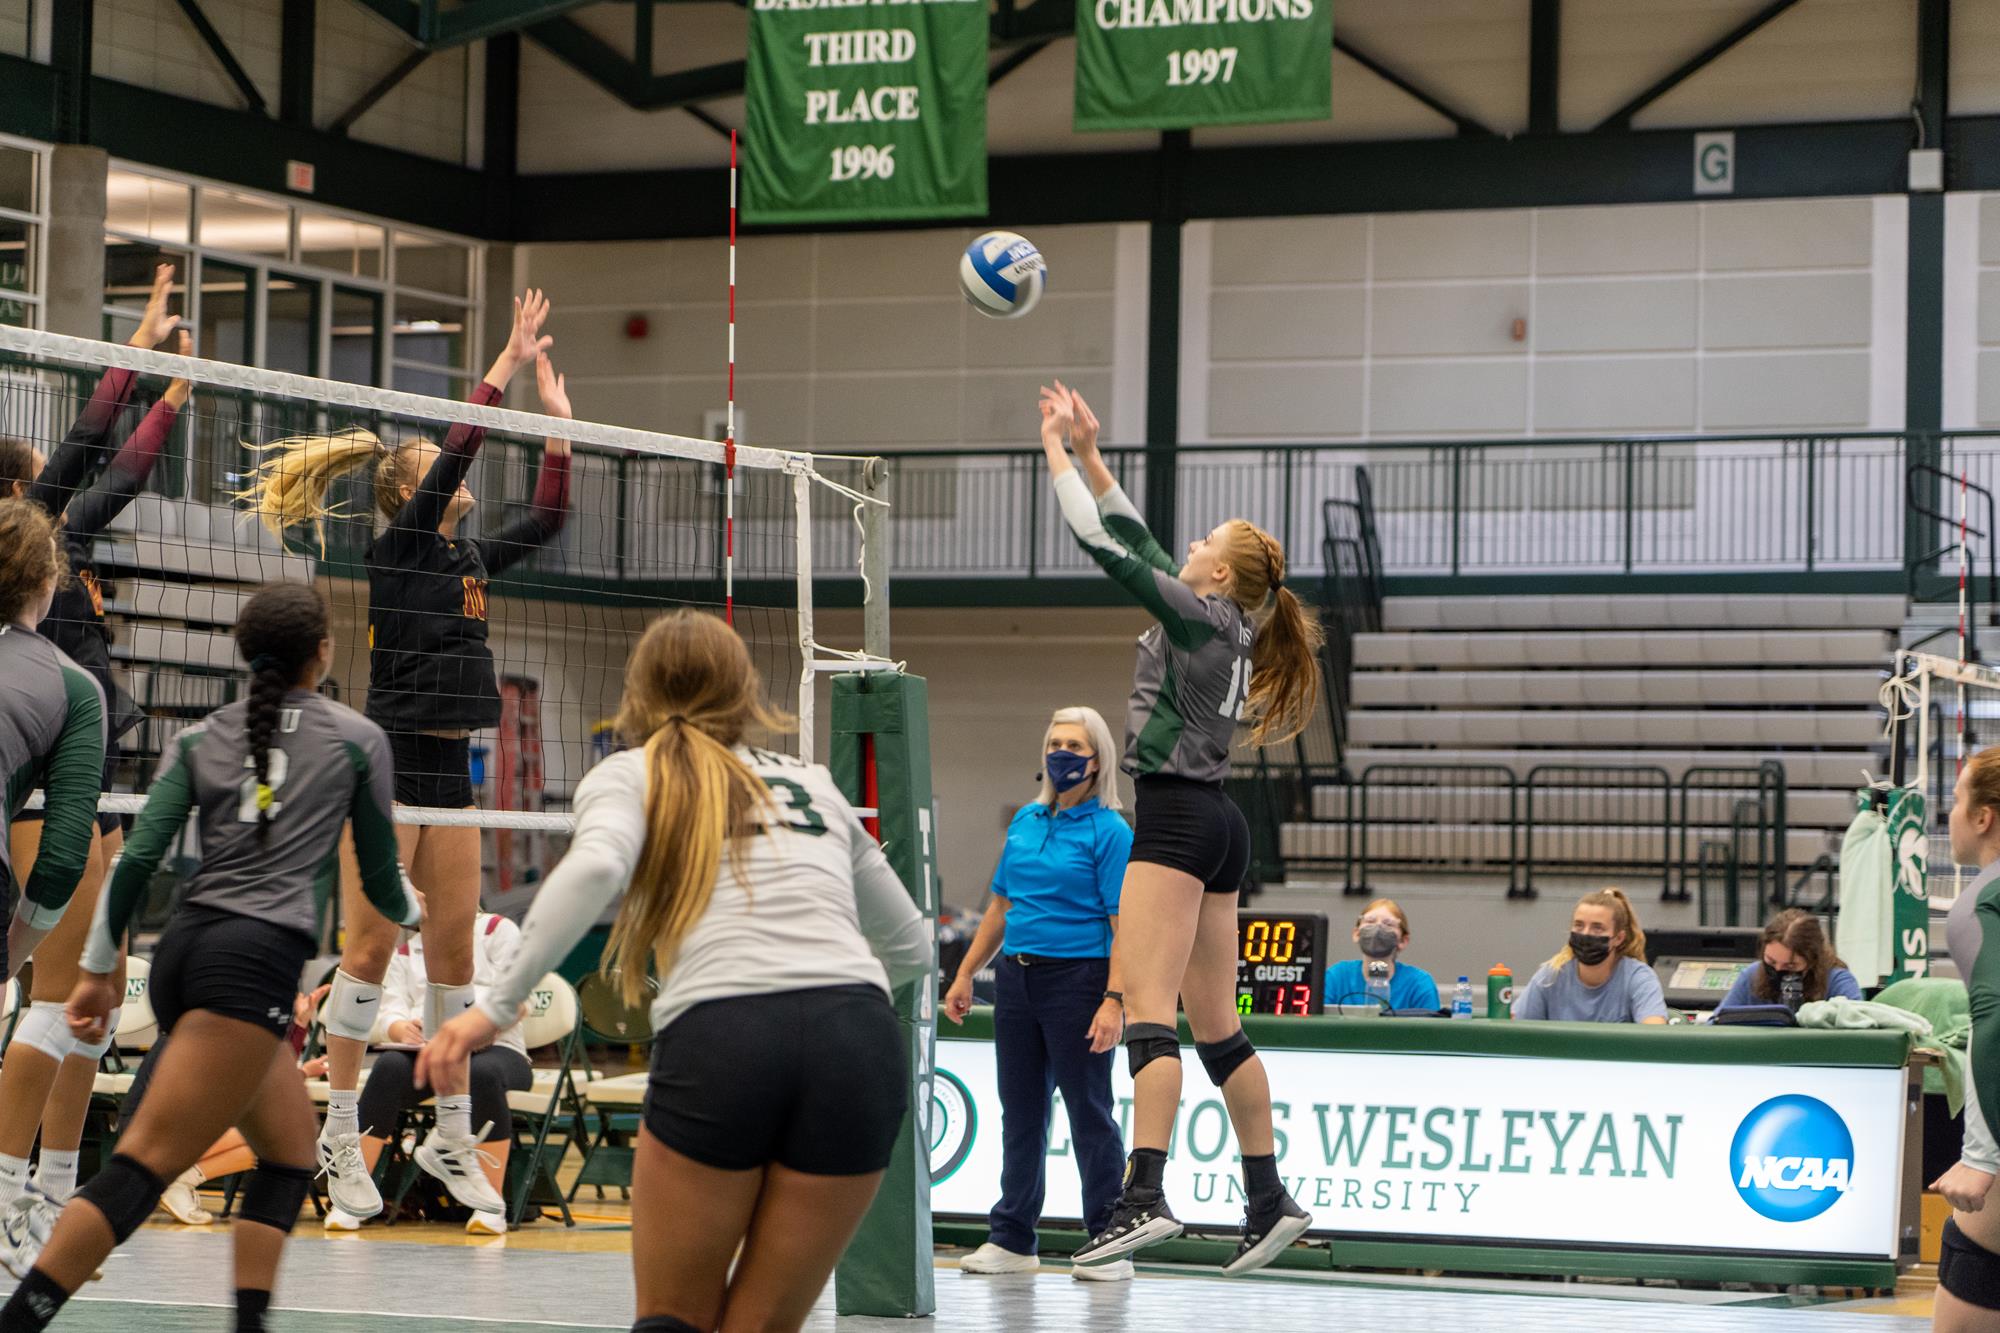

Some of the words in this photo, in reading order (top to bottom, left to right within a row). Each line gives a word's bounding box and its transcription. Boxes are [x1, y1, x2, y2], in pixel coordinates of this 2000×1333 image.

[1095, 0, 1314, 29] CHAMPIONS
[804, 29, 916, 67] THIRD
[1166, 47, 1238, 85] 1997
[804, 86, 919, 124] PLACE
[830, 144, 896, 181] 1996
[1700, 143, 1728, 182] G
[1218, 655, 1253, 720] 1
[1244, 921, 1295, 962] 00
[1254, 965, 1305, 982] GUEST
[1313, 1104, 1683, 1179] WESLEYAN
[1193, 1172, 1480, 1213] UNVERSITY
[1738, 1155, 1849, 1192] NCAA
